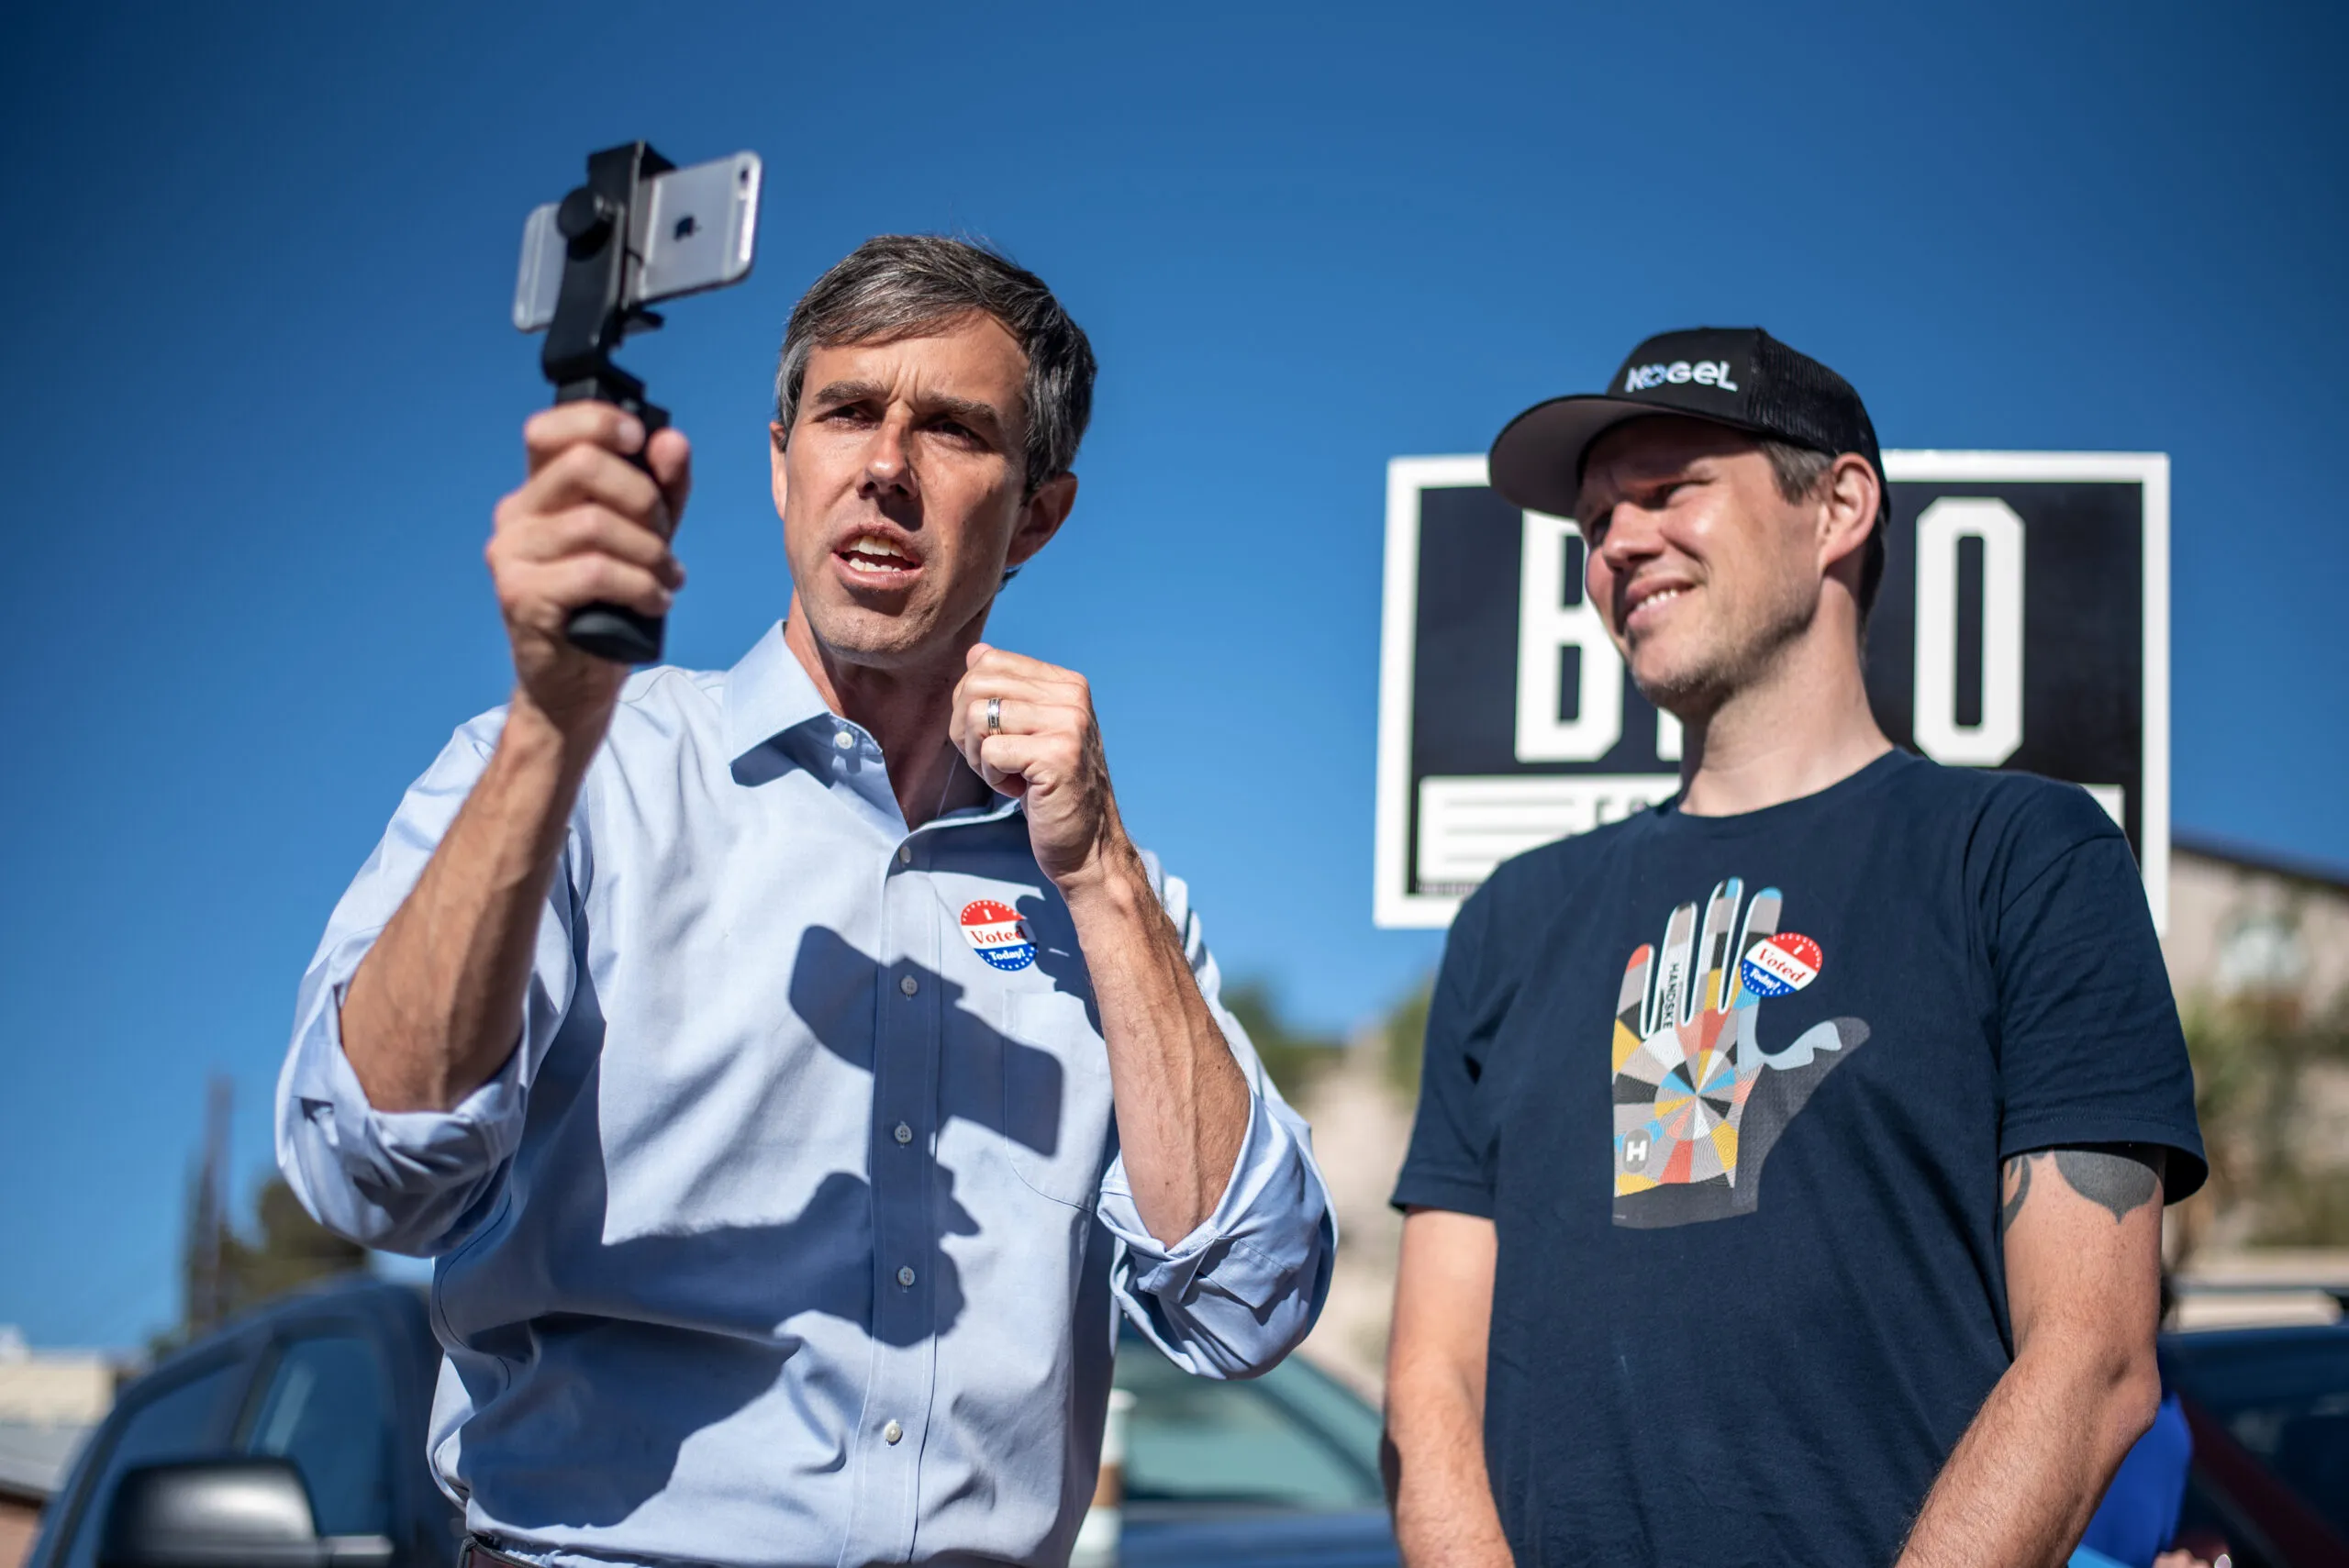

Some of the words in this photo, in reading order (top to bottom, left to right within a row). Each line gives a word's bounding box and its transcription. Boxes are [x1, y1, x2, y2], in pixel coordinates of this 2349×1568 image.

[1514, 496, 2026, 767] BO
[983, 908, 993, 921] I
[970, 925, 1027, 944] Voted
[988, 948, 1026, 961] Today!
[1793, 944, 1805, 955] I
[1758, 948, 1807, 983] Voted
[1663, 963, 1680, 1029] HANDSKE
[1626, 1140, 1647, 1162] H
